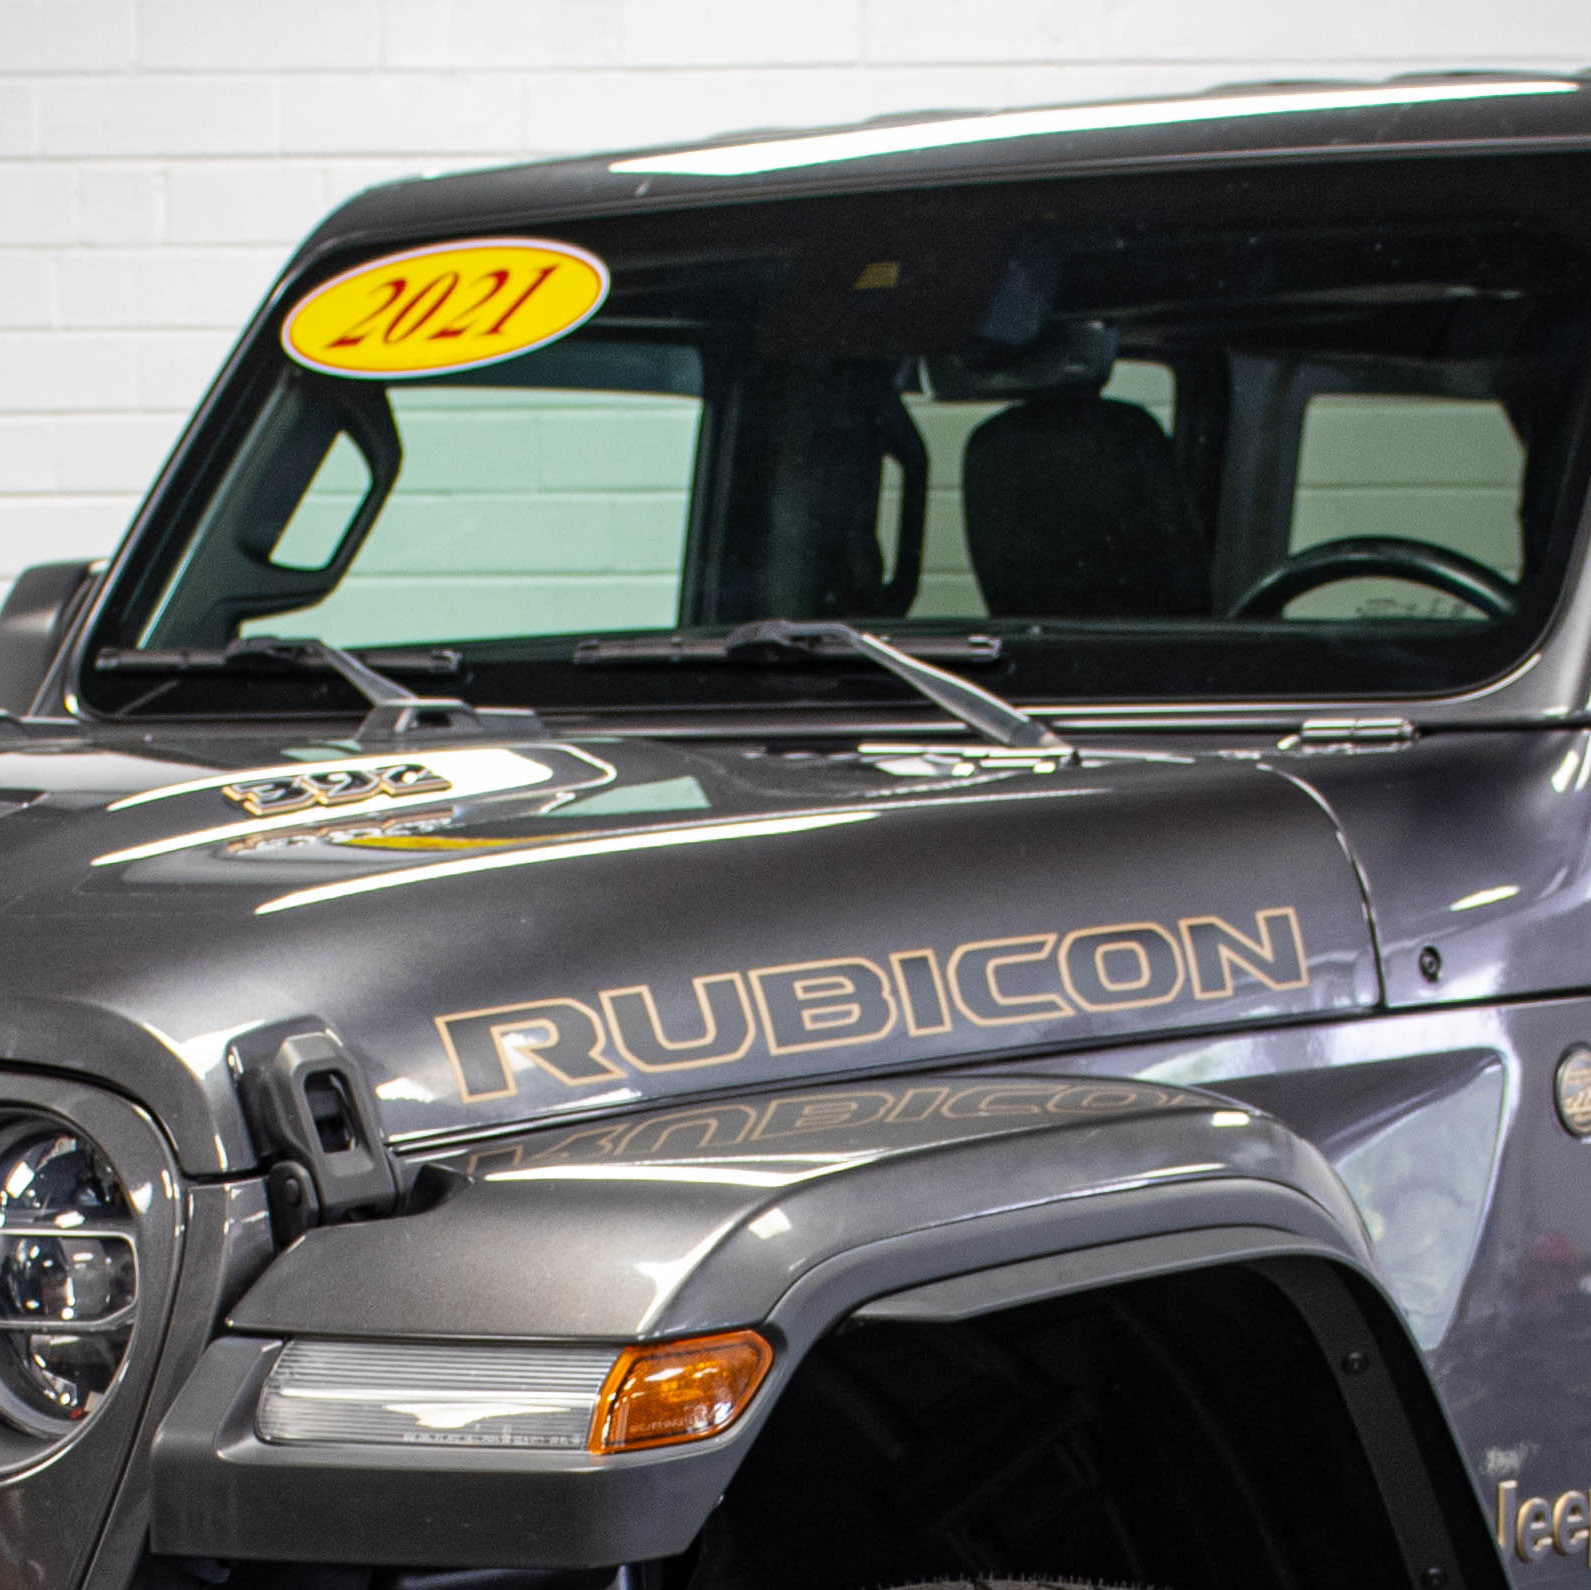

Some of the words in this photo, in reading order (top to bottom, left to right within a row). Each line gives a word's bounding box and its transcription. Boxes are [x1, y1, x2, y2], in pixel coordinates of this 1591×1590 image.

[327, 263, 560, 349] 2021
[222, 764, 453, 816] 392
[434, 906, 1310, 1104] RUBICON
